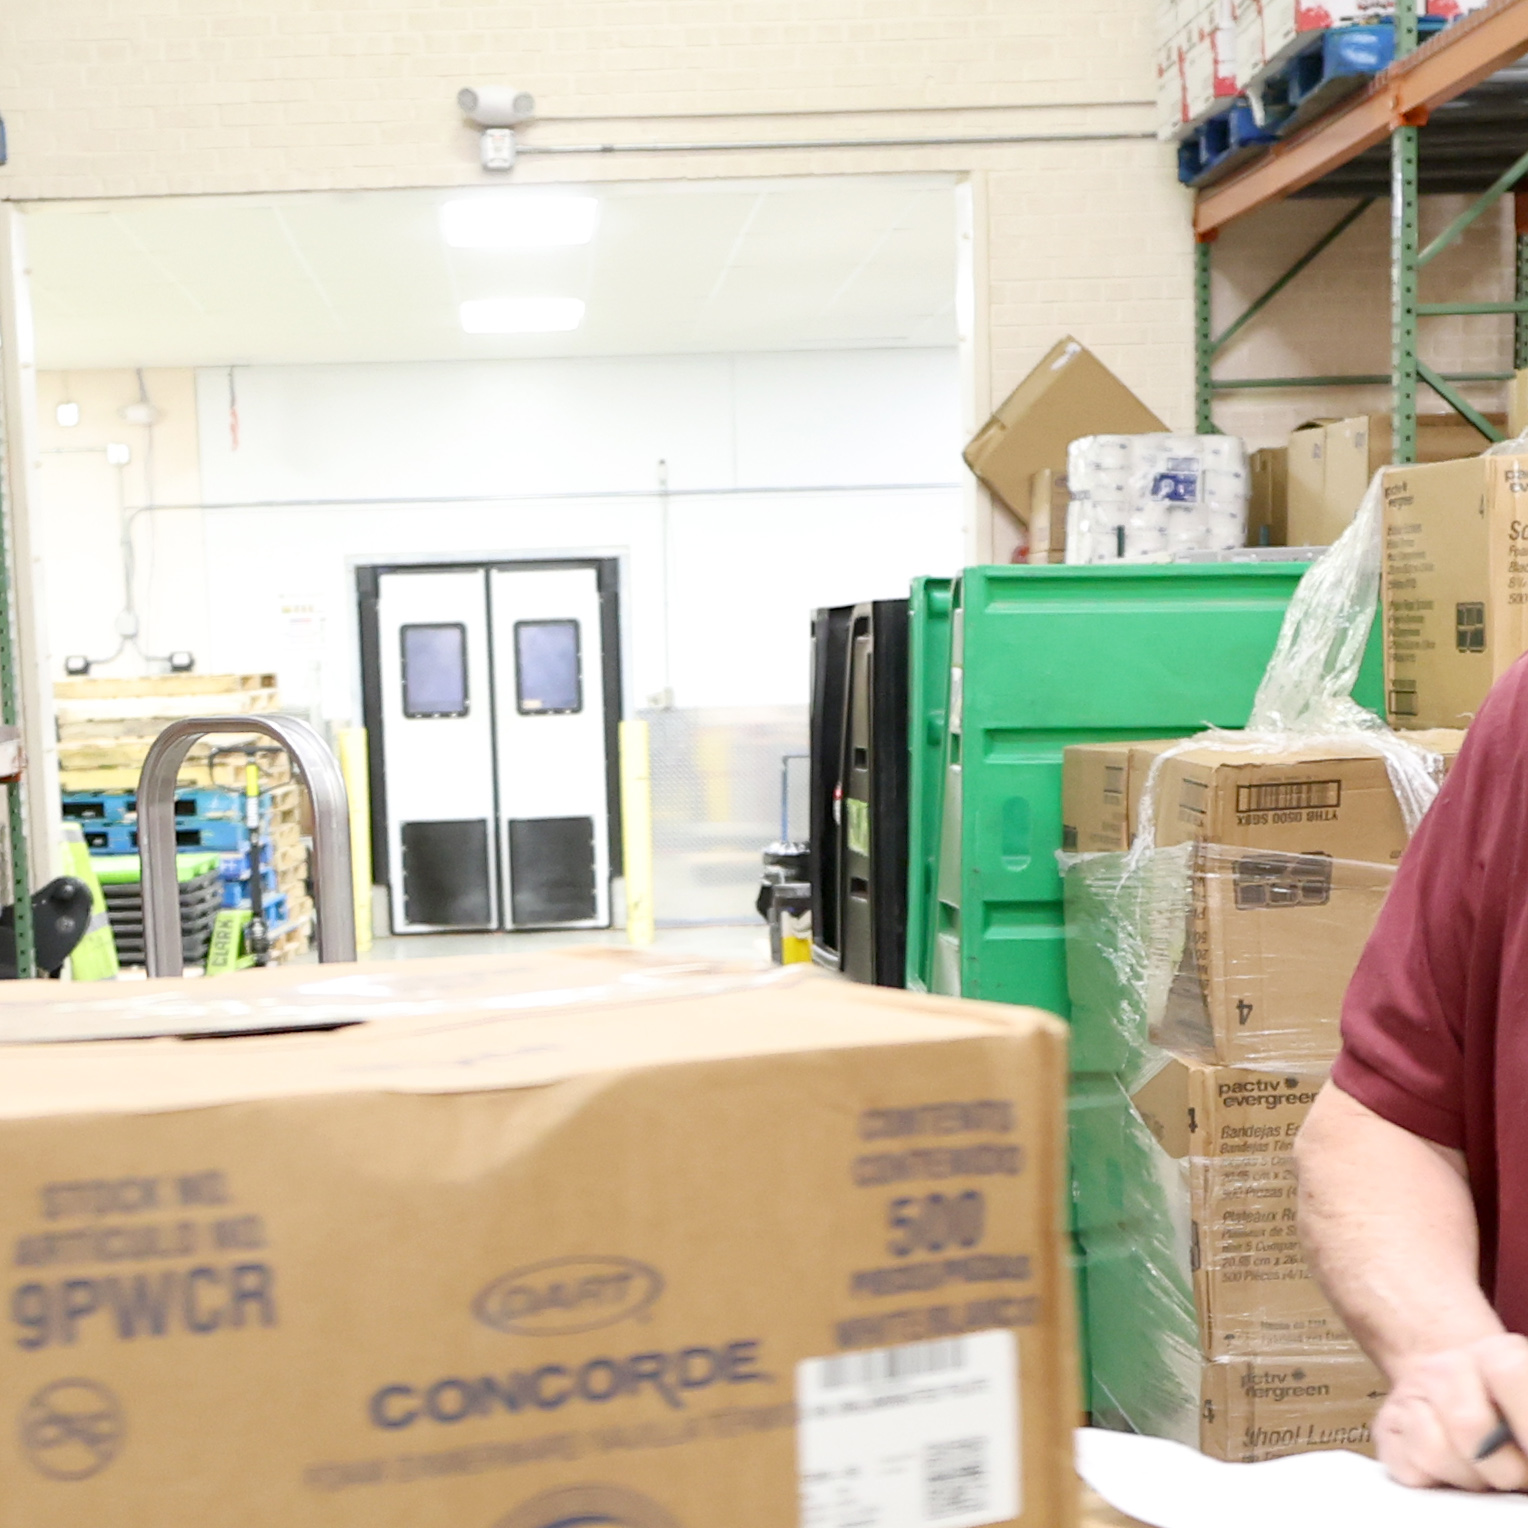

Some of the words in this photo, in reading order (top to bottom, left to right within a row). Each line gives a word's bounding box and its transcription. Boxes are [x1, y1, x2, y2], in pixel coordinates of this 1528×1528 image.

[1219, 1078, 1280, 1099] pactiv
[1222, 1124, 1280, 1139] Bandejas
[886, 1190, 986, 1256] 500
[11, 1262, 278, 1350] 9PWCR
[495, 1271, 633, 1321] DART
[370, 1340, 764, 1431] CONCORDE
